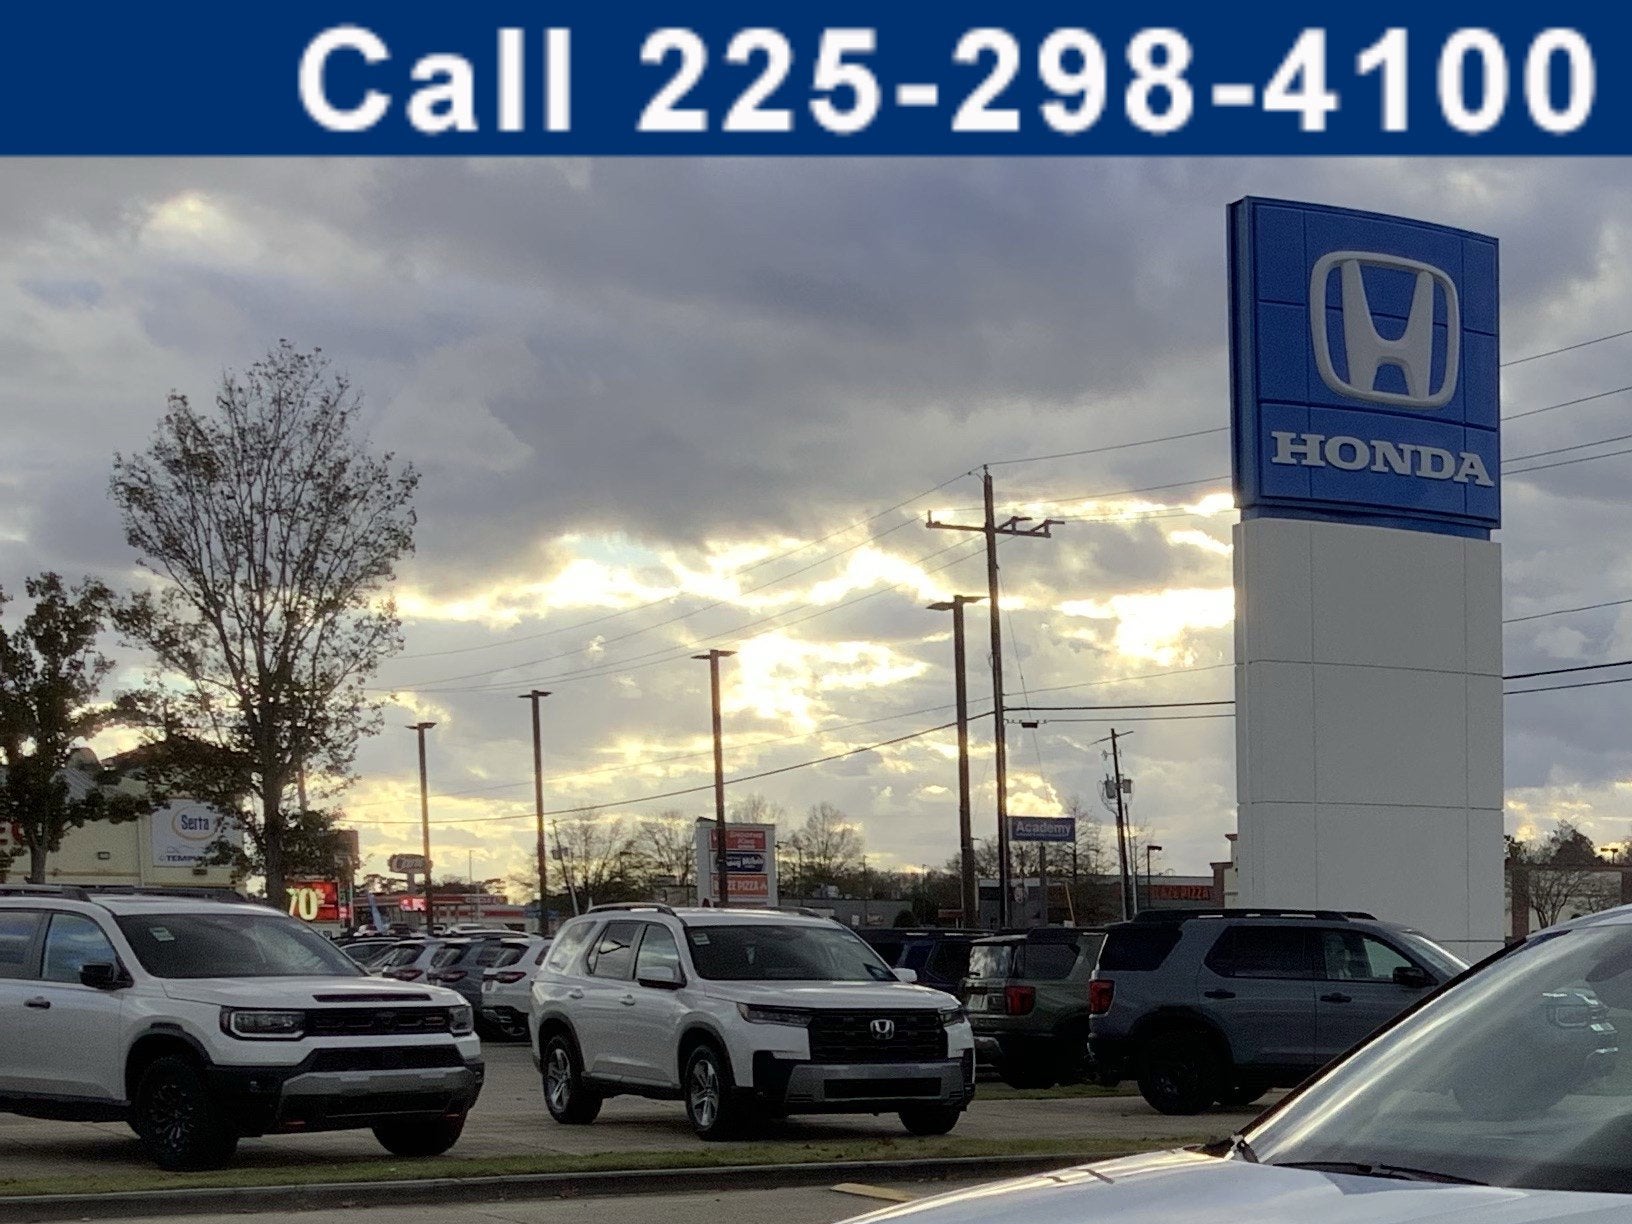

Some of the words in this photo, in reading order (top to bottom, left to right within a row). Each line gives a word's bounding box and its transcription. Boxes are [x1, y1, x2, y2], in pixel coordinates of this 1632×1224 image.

[1271, 430, 1495, 487] HONDA
[181, 814, 209, 830] Serta
[1016, 820, 1072, 837] Academy
